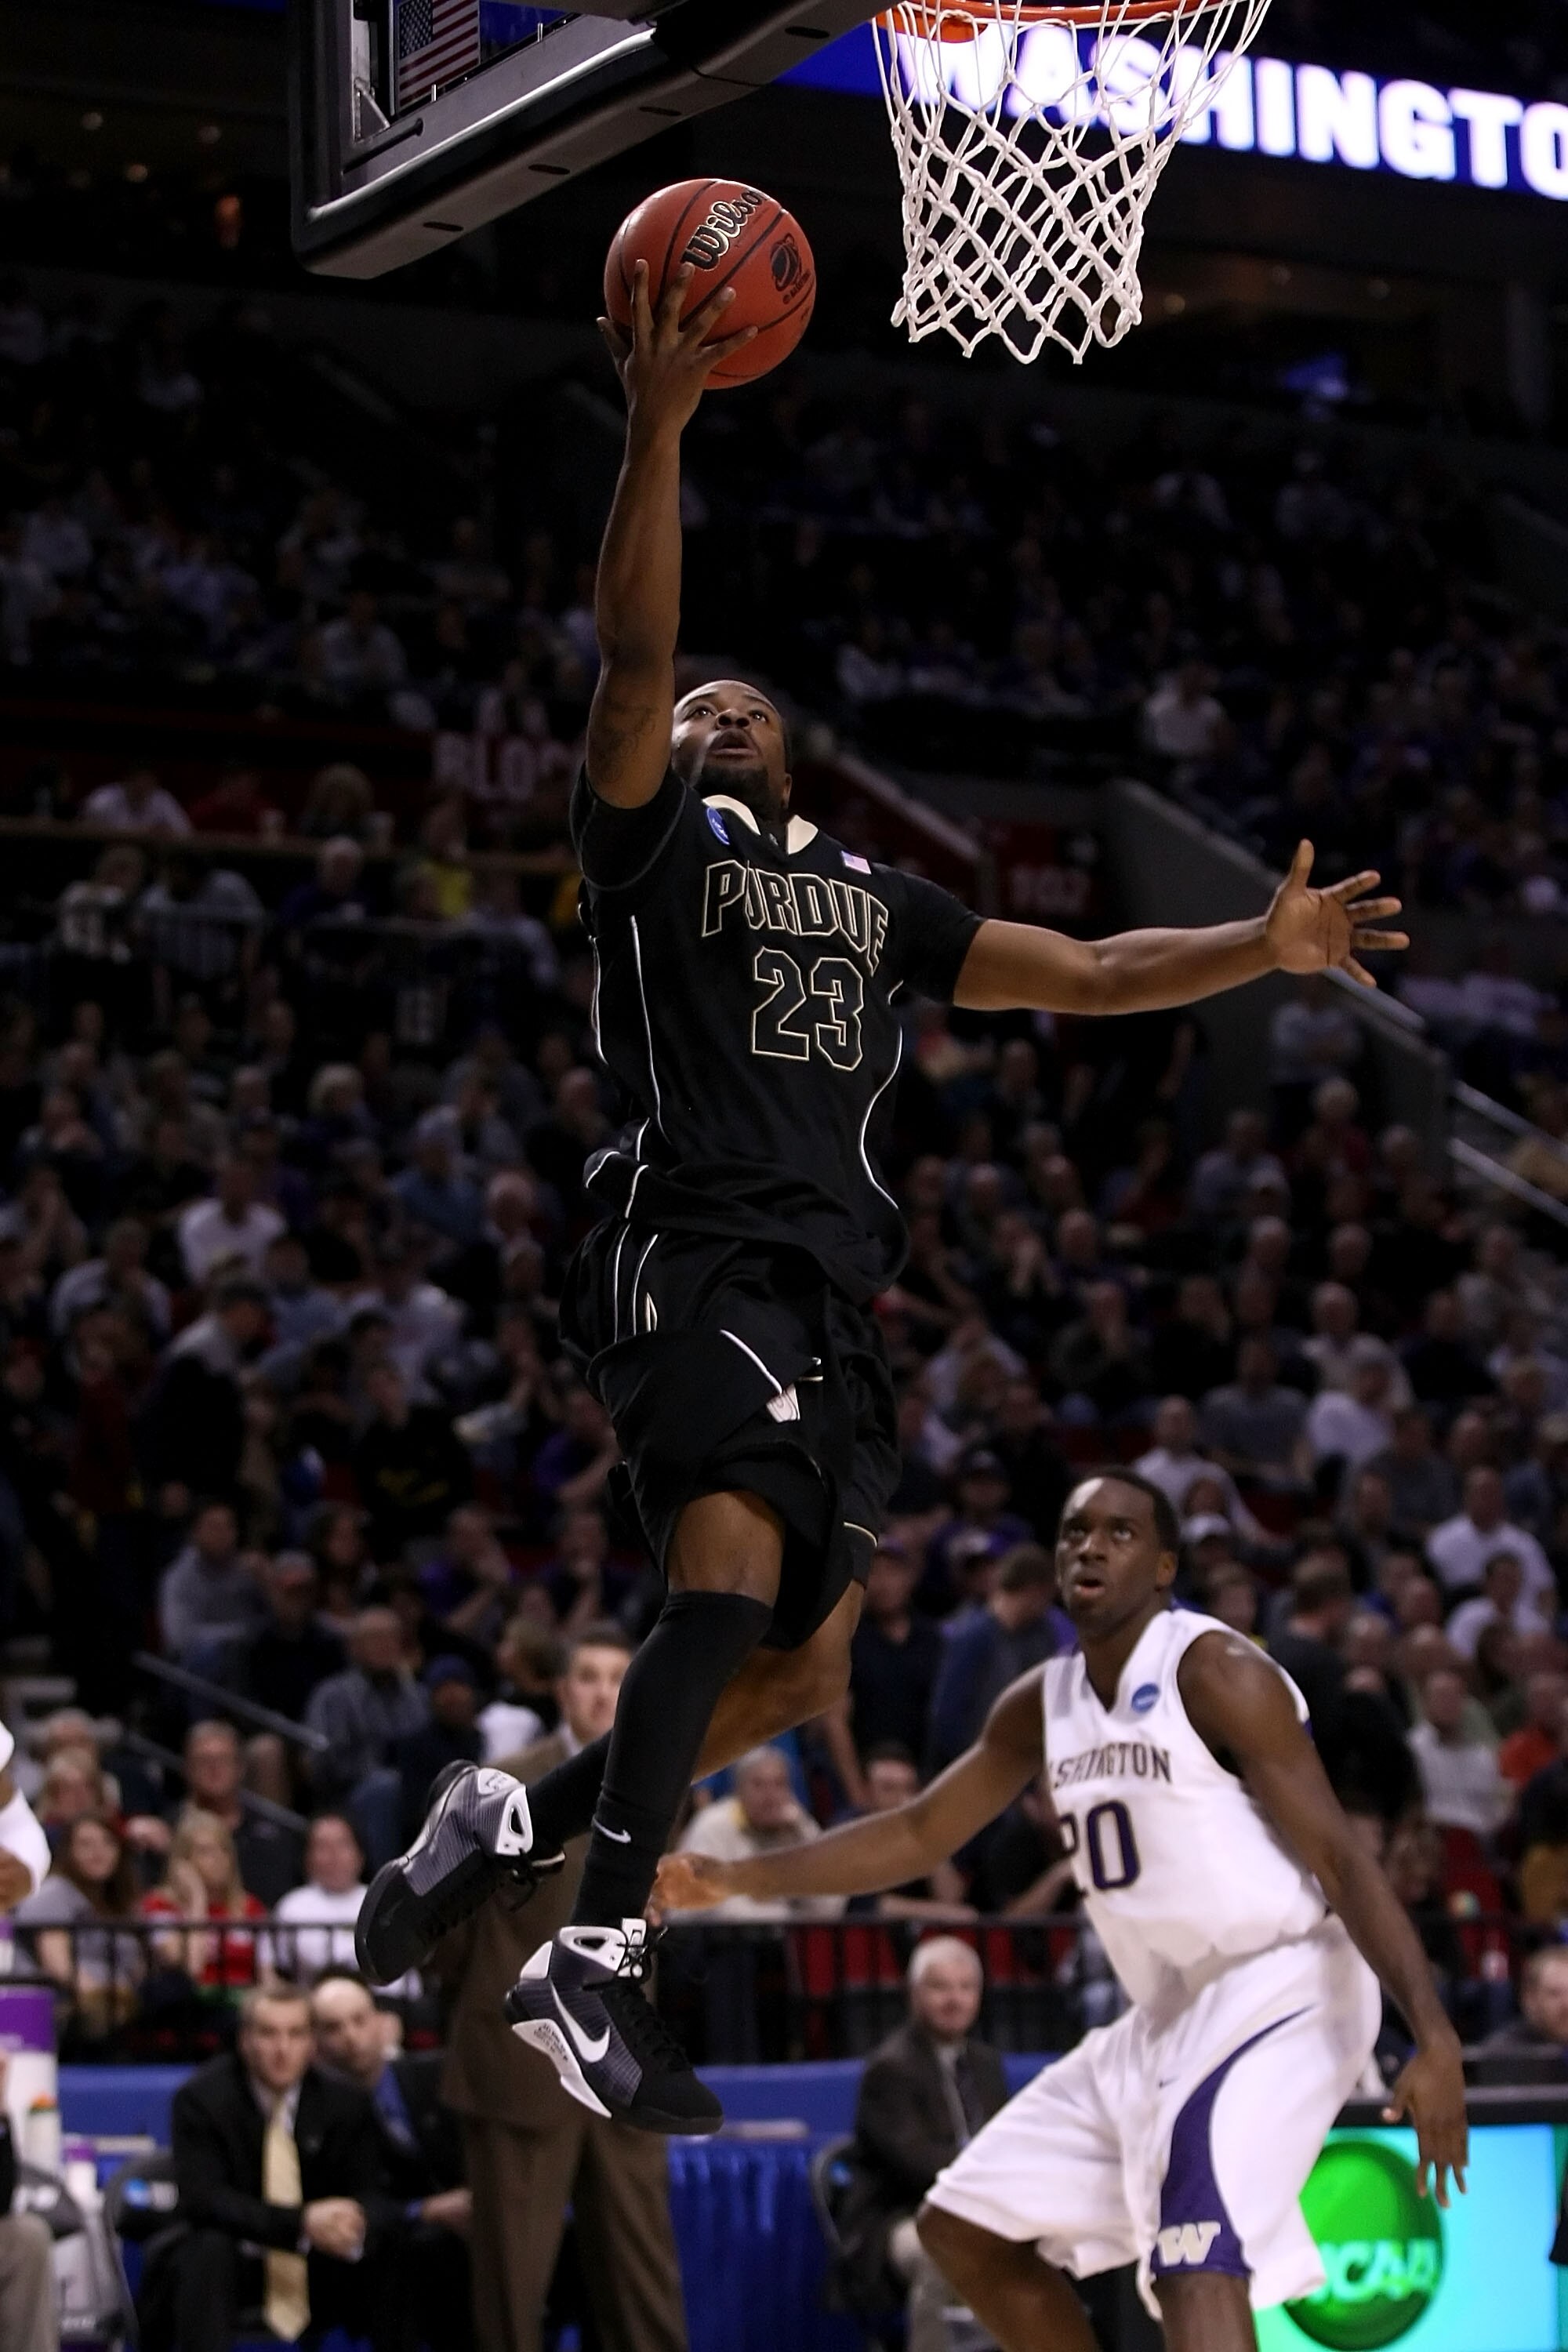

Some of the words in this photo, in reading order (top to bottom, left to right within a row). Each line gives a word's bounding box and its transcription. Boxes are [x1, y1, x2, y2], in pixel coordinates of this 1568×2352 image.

[702, 859, 889, 978] PURDUE
[752, 946, 864, 1071] 23
[1157, 2221, 1221, 2267] W
